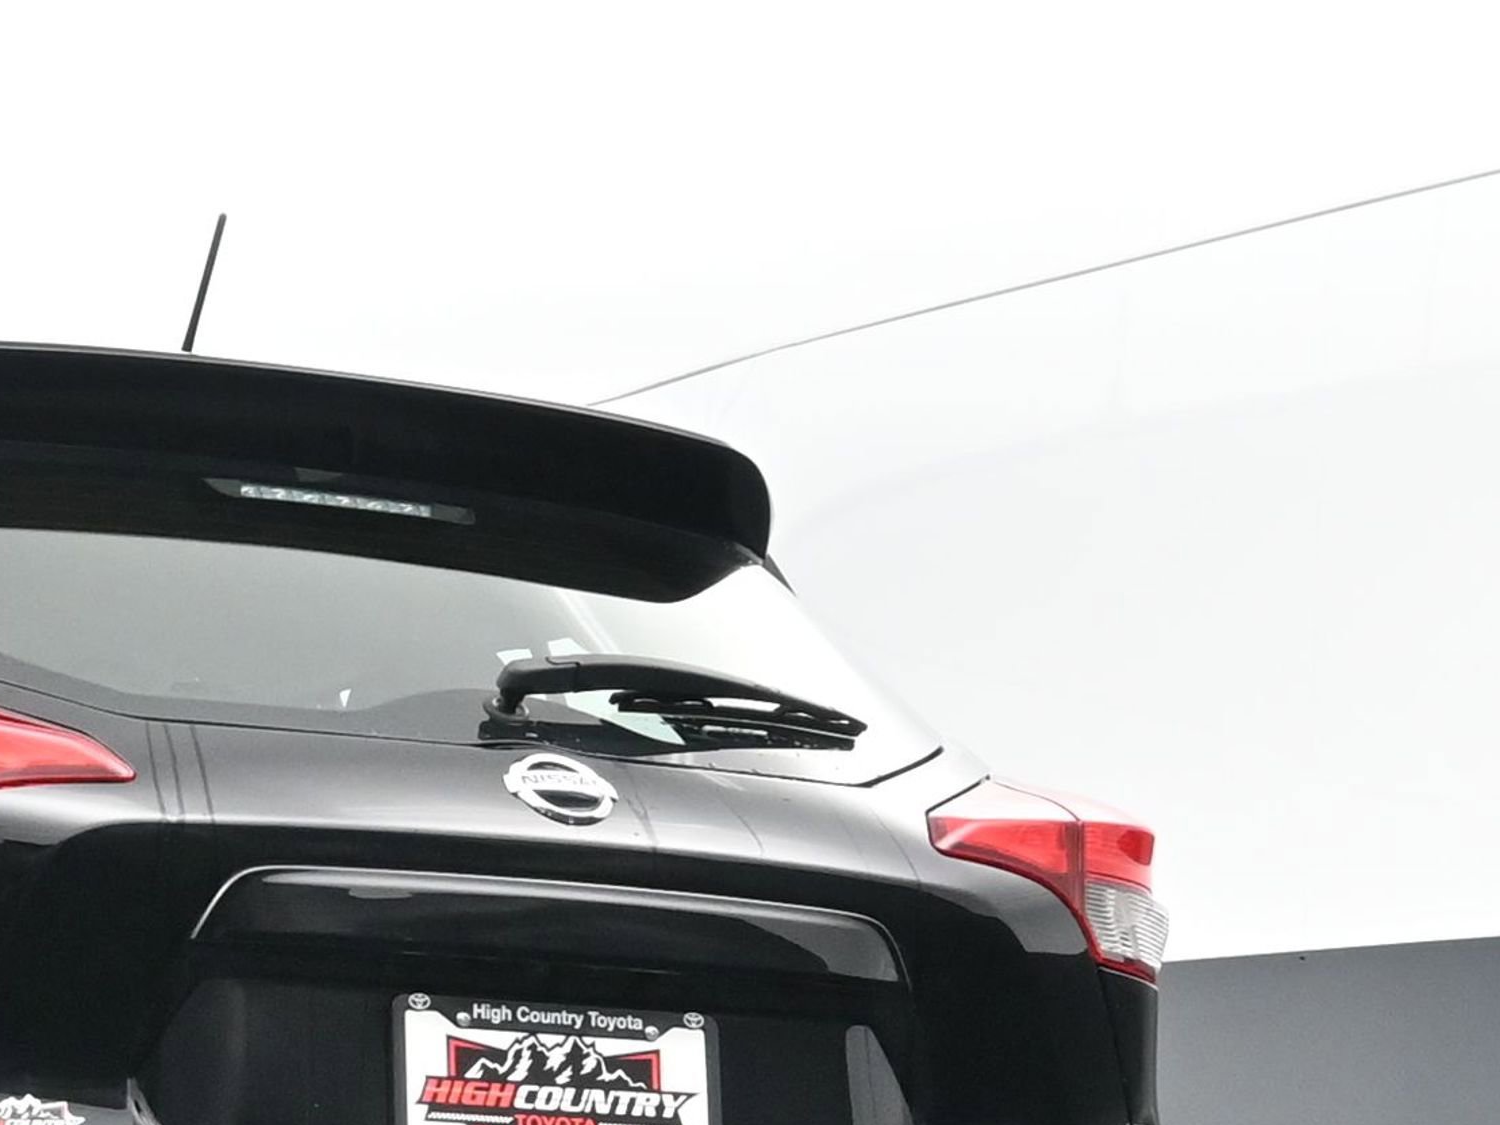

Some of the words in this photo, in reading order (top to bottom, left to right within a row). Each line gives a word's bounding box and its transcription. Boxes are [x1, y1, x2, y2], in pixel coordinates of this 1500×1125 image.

[472, 1003, 512, 1024] High
[516, 1006, 584, 1029] Country
[587, 1011, 644, 1031] Toyota
[421, 1078, 516, 1108] HIGH
[513, 1084, 688, 1119] COUNTRY
